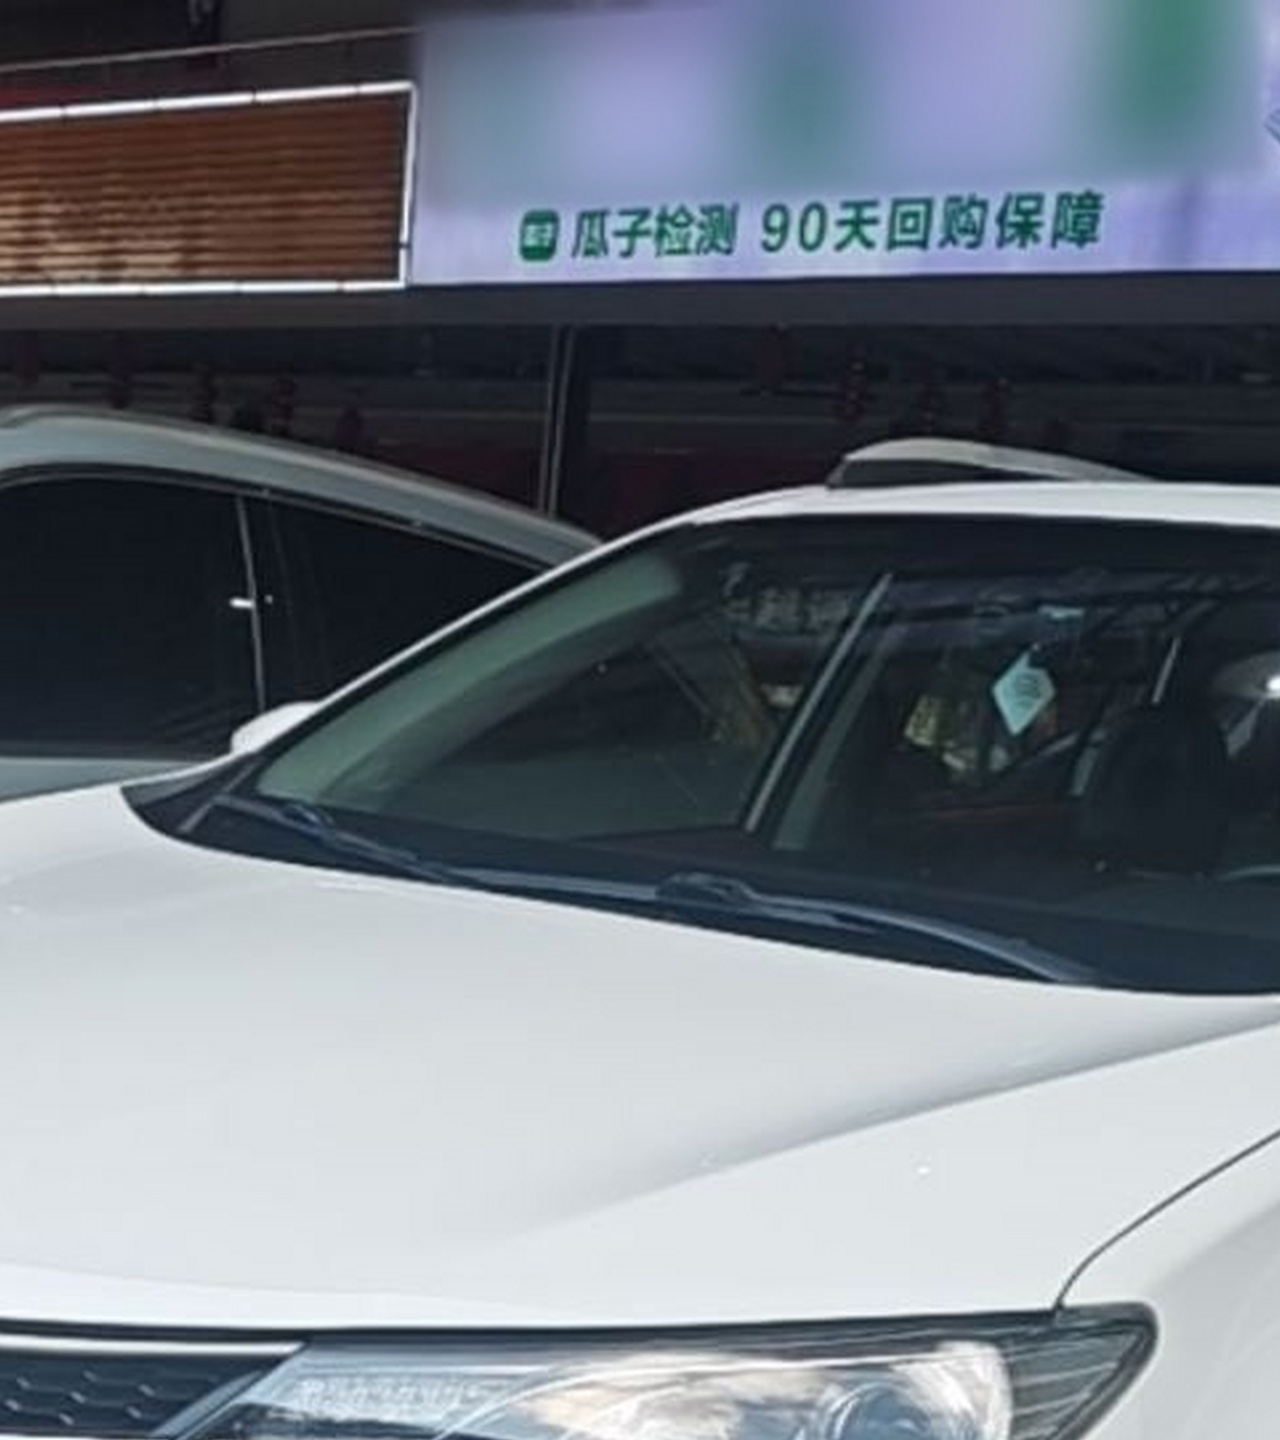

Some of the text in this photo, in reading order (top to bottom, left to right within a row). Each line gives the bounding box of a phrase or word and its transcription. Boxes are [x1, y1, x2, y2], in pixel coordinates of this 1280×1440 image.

[571, 202, 739, 258] 瓜子检测
[761, 190, 1105, 252] 90天回购保障
